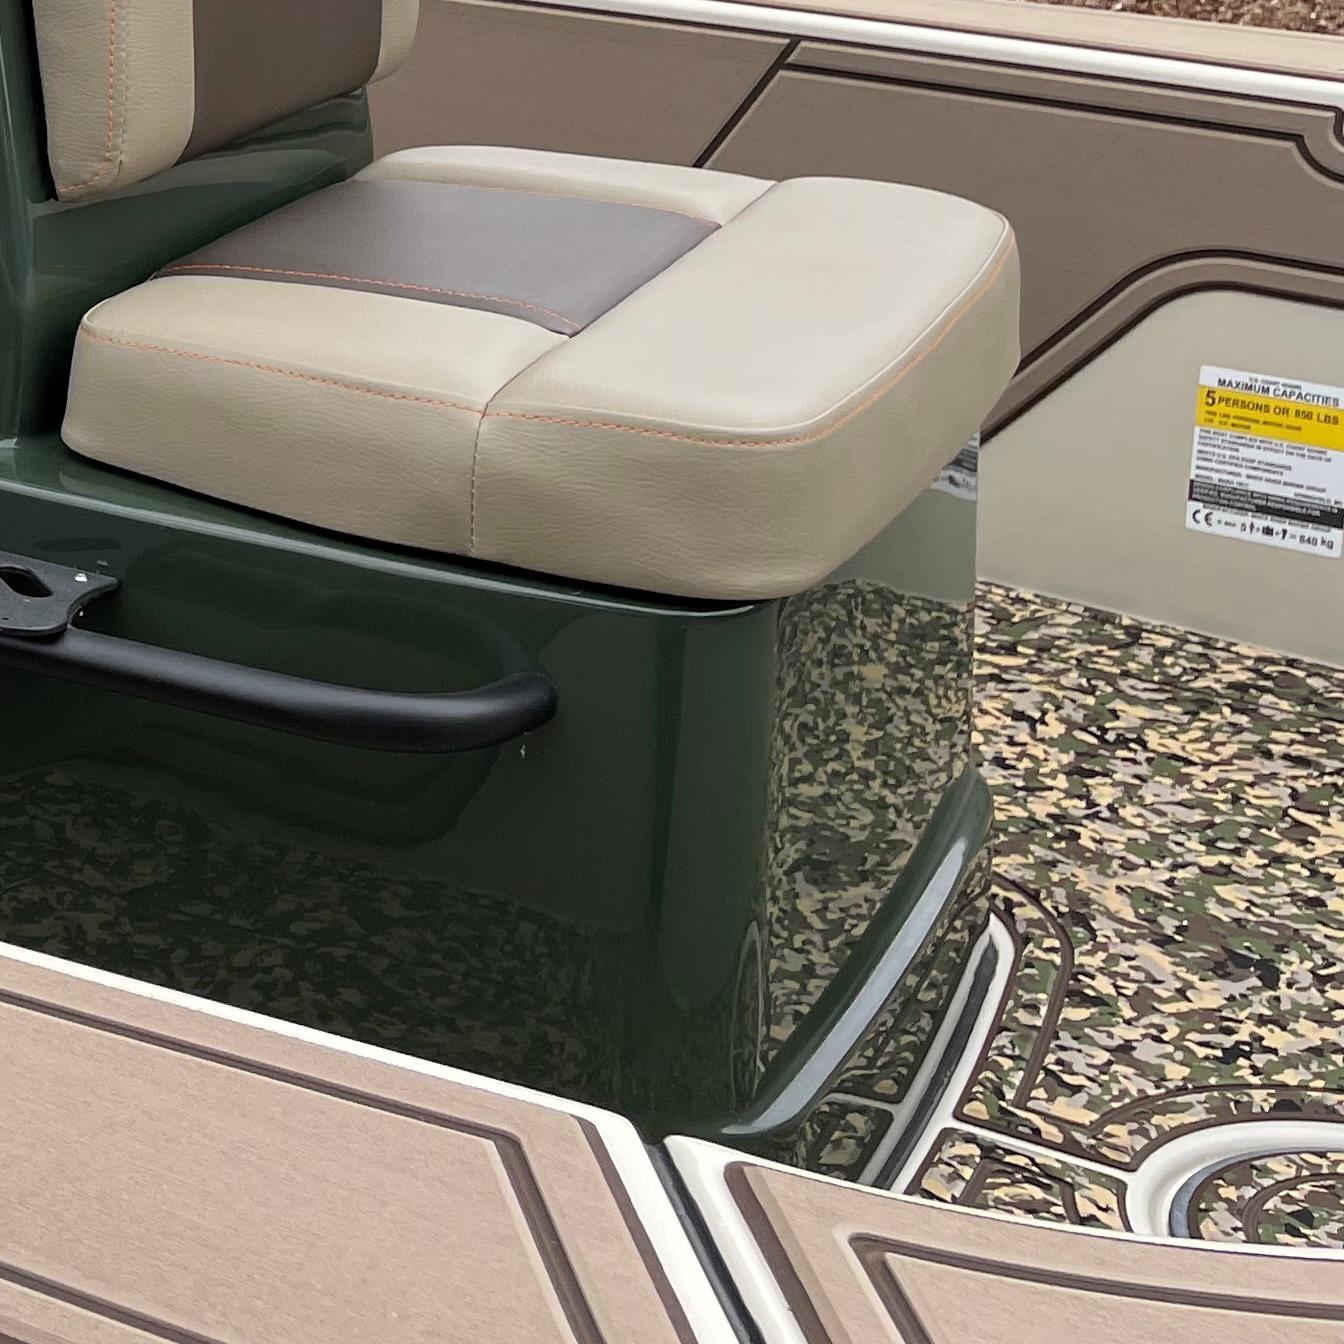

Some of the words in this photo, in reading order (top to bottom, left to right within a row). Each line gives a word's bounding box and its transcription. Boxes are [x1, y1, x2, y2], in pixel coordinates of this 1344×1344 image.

[1205, 390, 1216, 407] 5
[1217, 397, 1271, 414] PERSONS
[1273, 406, 1290, 419] OR
[1317, 411, 1339, 426] LBS
[1217, 378, 1270, 395] MAXIMUM
[1273, 386, 1340, 407] CAPACITIES
